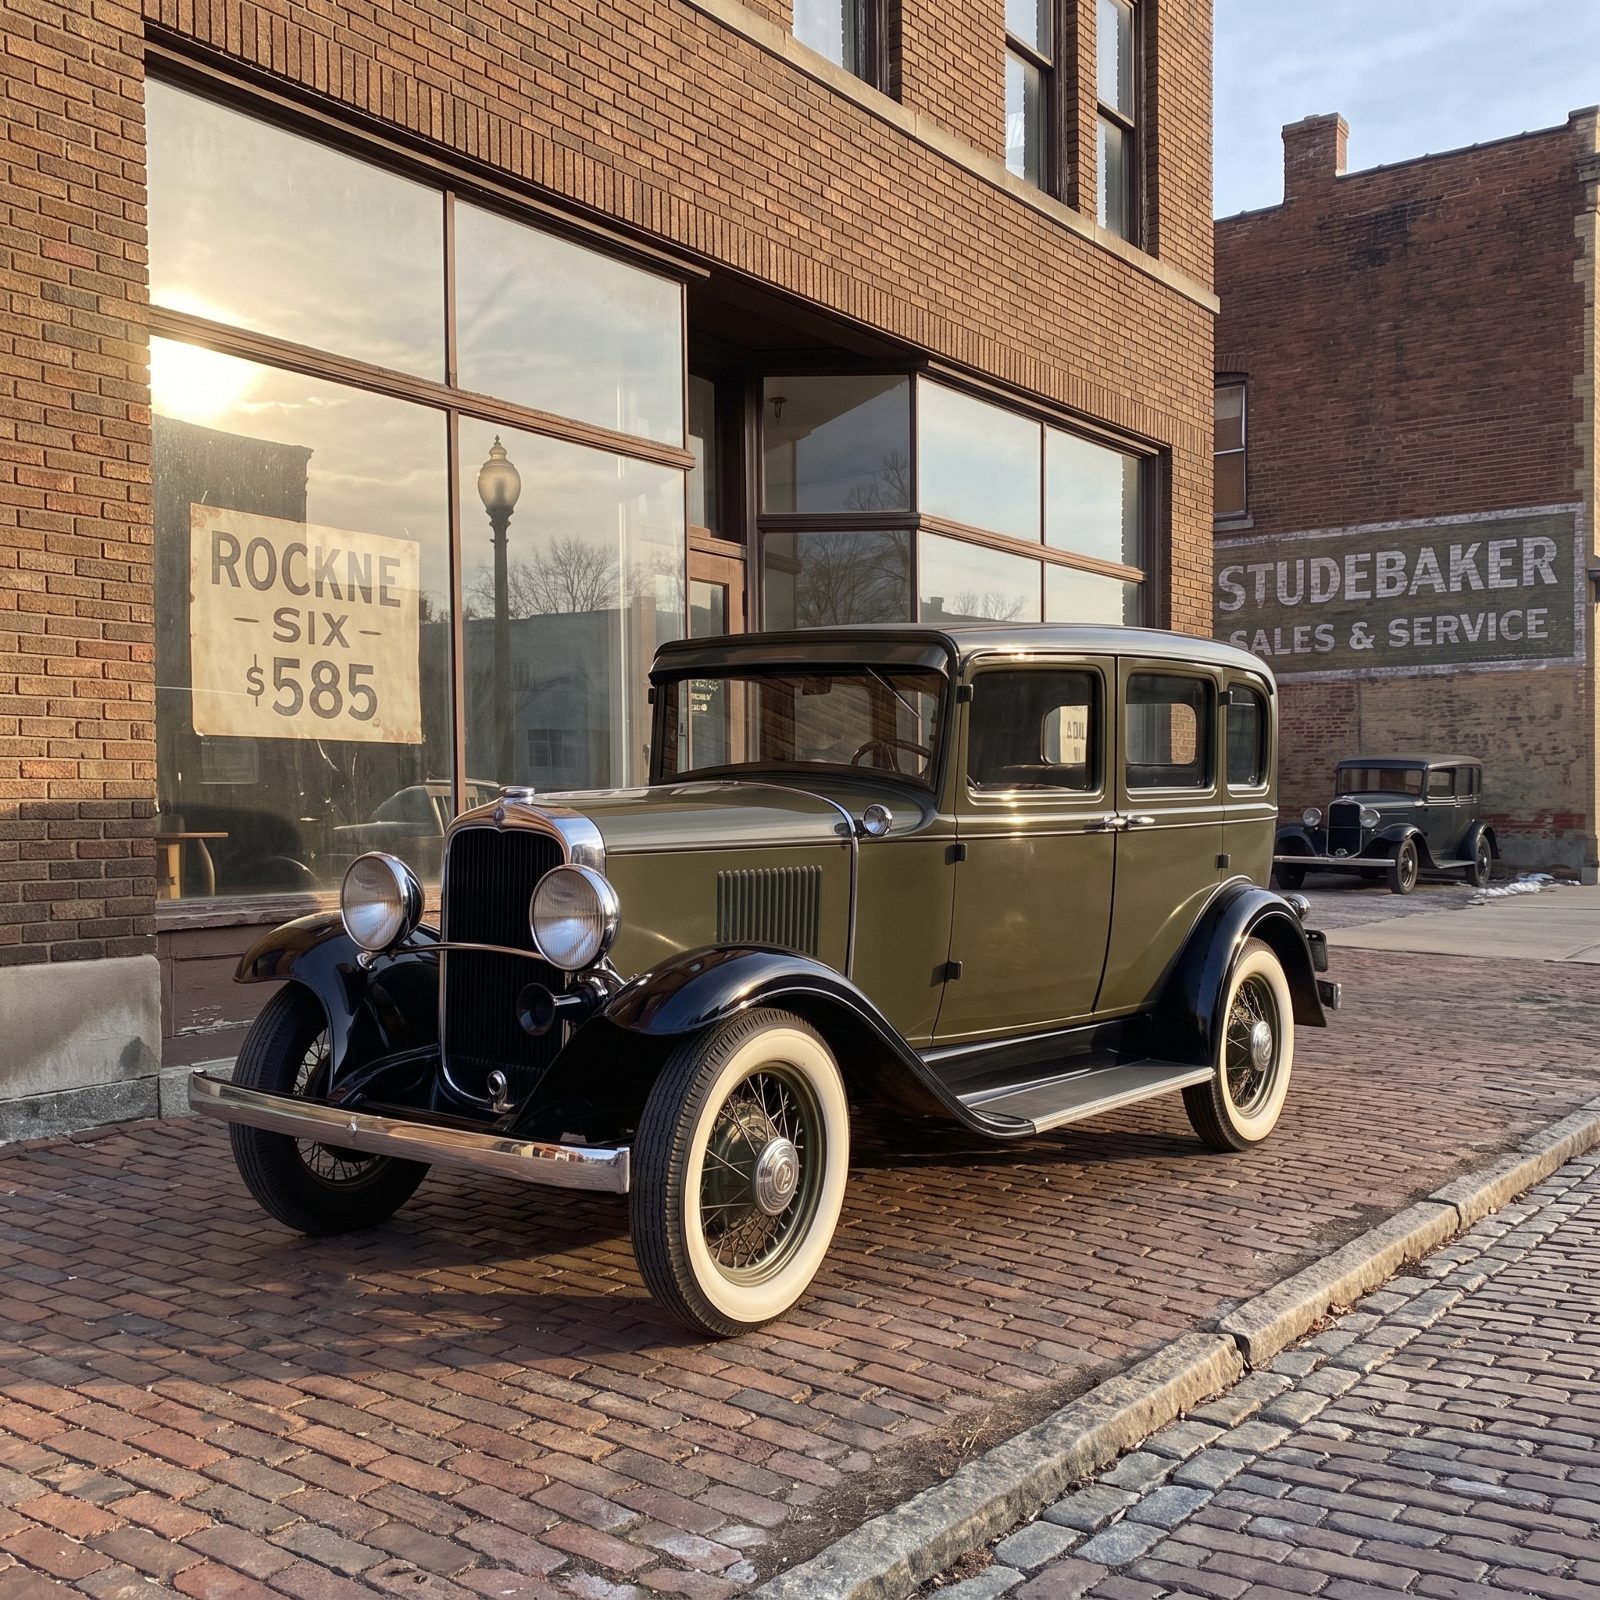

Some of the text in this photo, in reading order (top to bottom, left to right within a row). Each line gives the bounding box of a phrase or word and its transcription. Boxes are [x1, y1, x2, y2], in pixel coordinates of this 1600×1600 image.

[211, 530, 401, 608] ROCKNE
[1218, 536, 1558, 611] STUDEBAKER
[272, 607, 351, 649] SIX
[1229, 608, 1549, 656] SALES & SERVICE
[246, 654, 378, 721] $585
